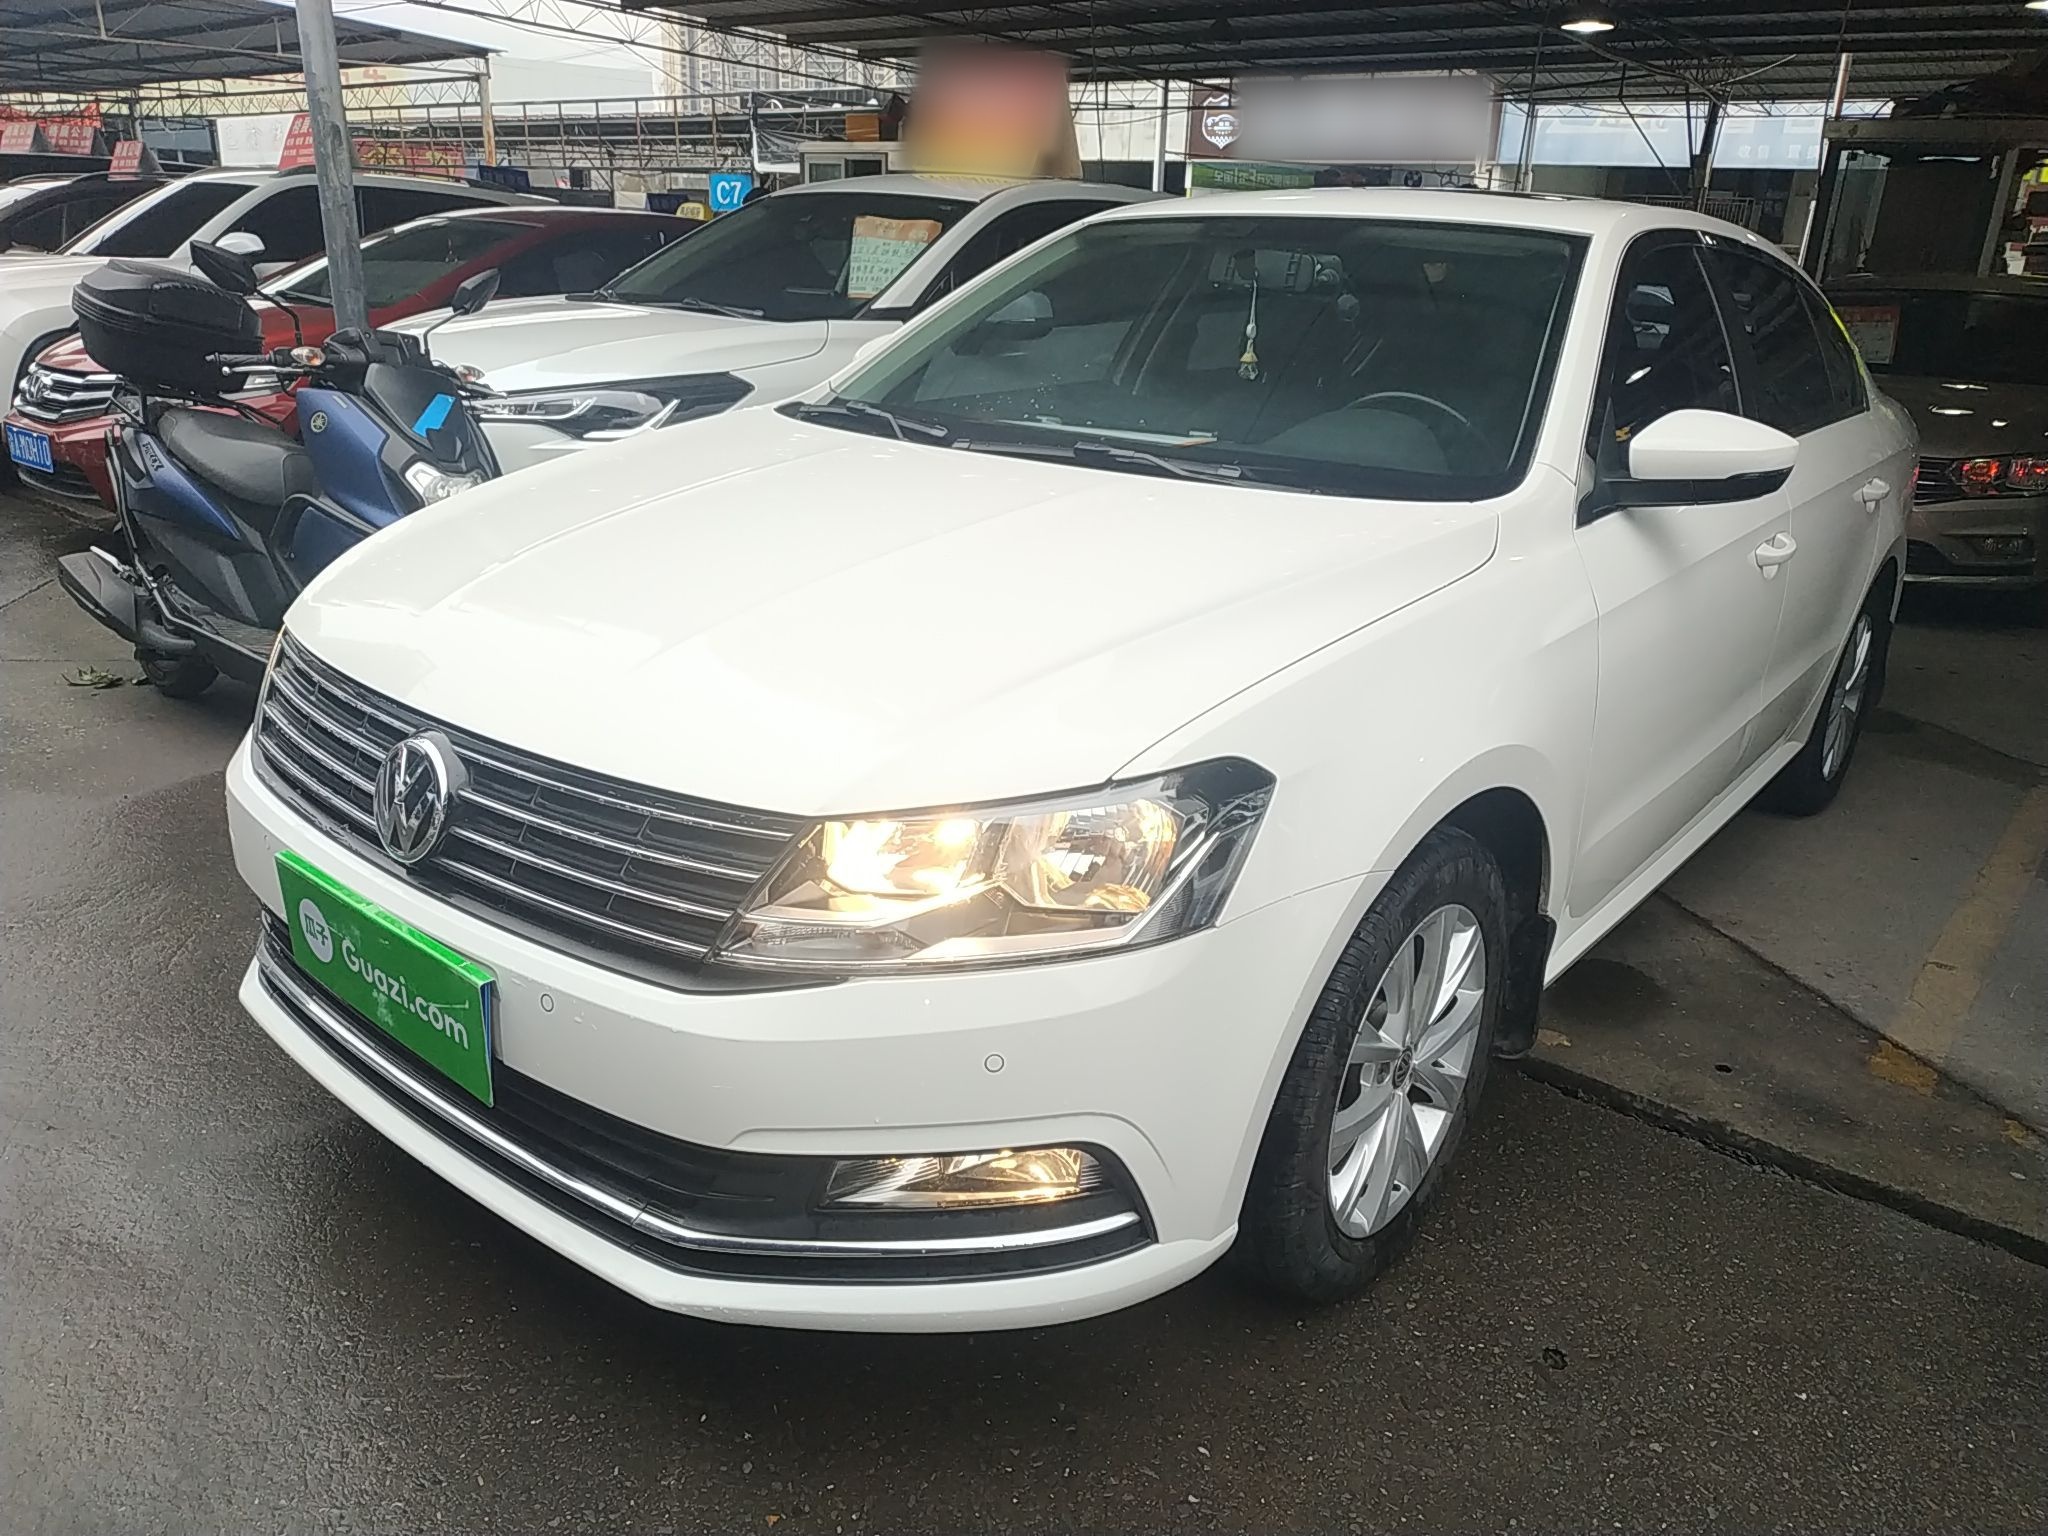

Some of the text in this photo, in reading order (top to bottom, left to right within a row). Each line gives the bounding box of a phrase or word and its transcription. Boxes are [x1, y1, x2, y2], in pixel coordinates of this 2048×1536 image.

[716, 181, 742, 204] C7
[303, 914, 469, 1050] 瓜子 Guazi.com
